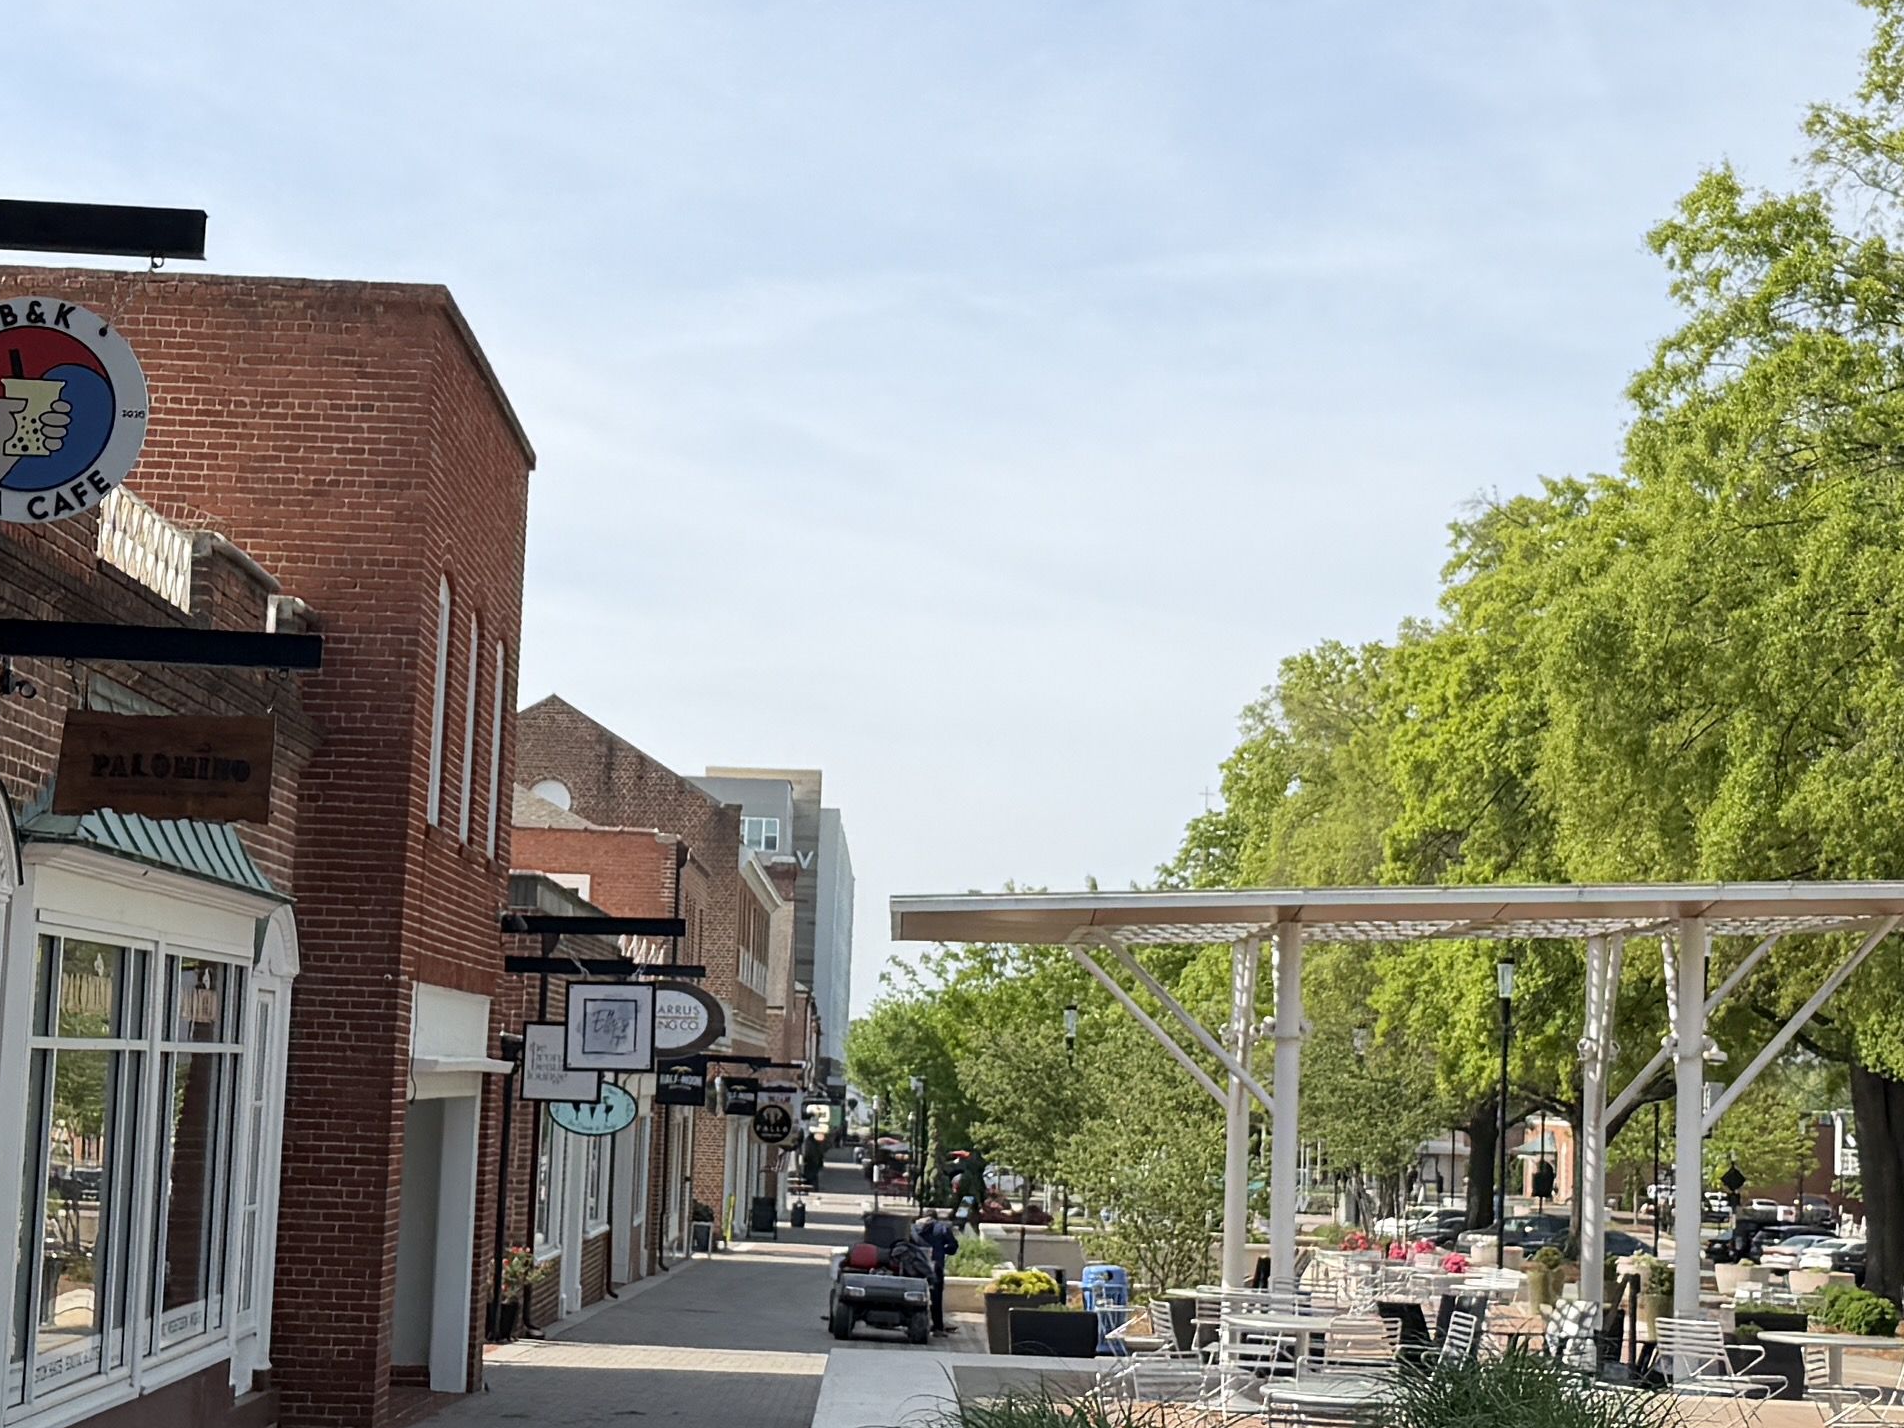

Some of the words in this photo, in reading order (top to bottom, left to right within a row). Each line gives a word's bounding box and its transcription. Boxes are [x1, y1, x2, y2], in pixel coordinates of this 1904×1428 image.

[27, 469, 112, 520] CAFE
[91, 752, 251, 783] PALOMINO
[658, 1004, 700, 1016] ARRUS
